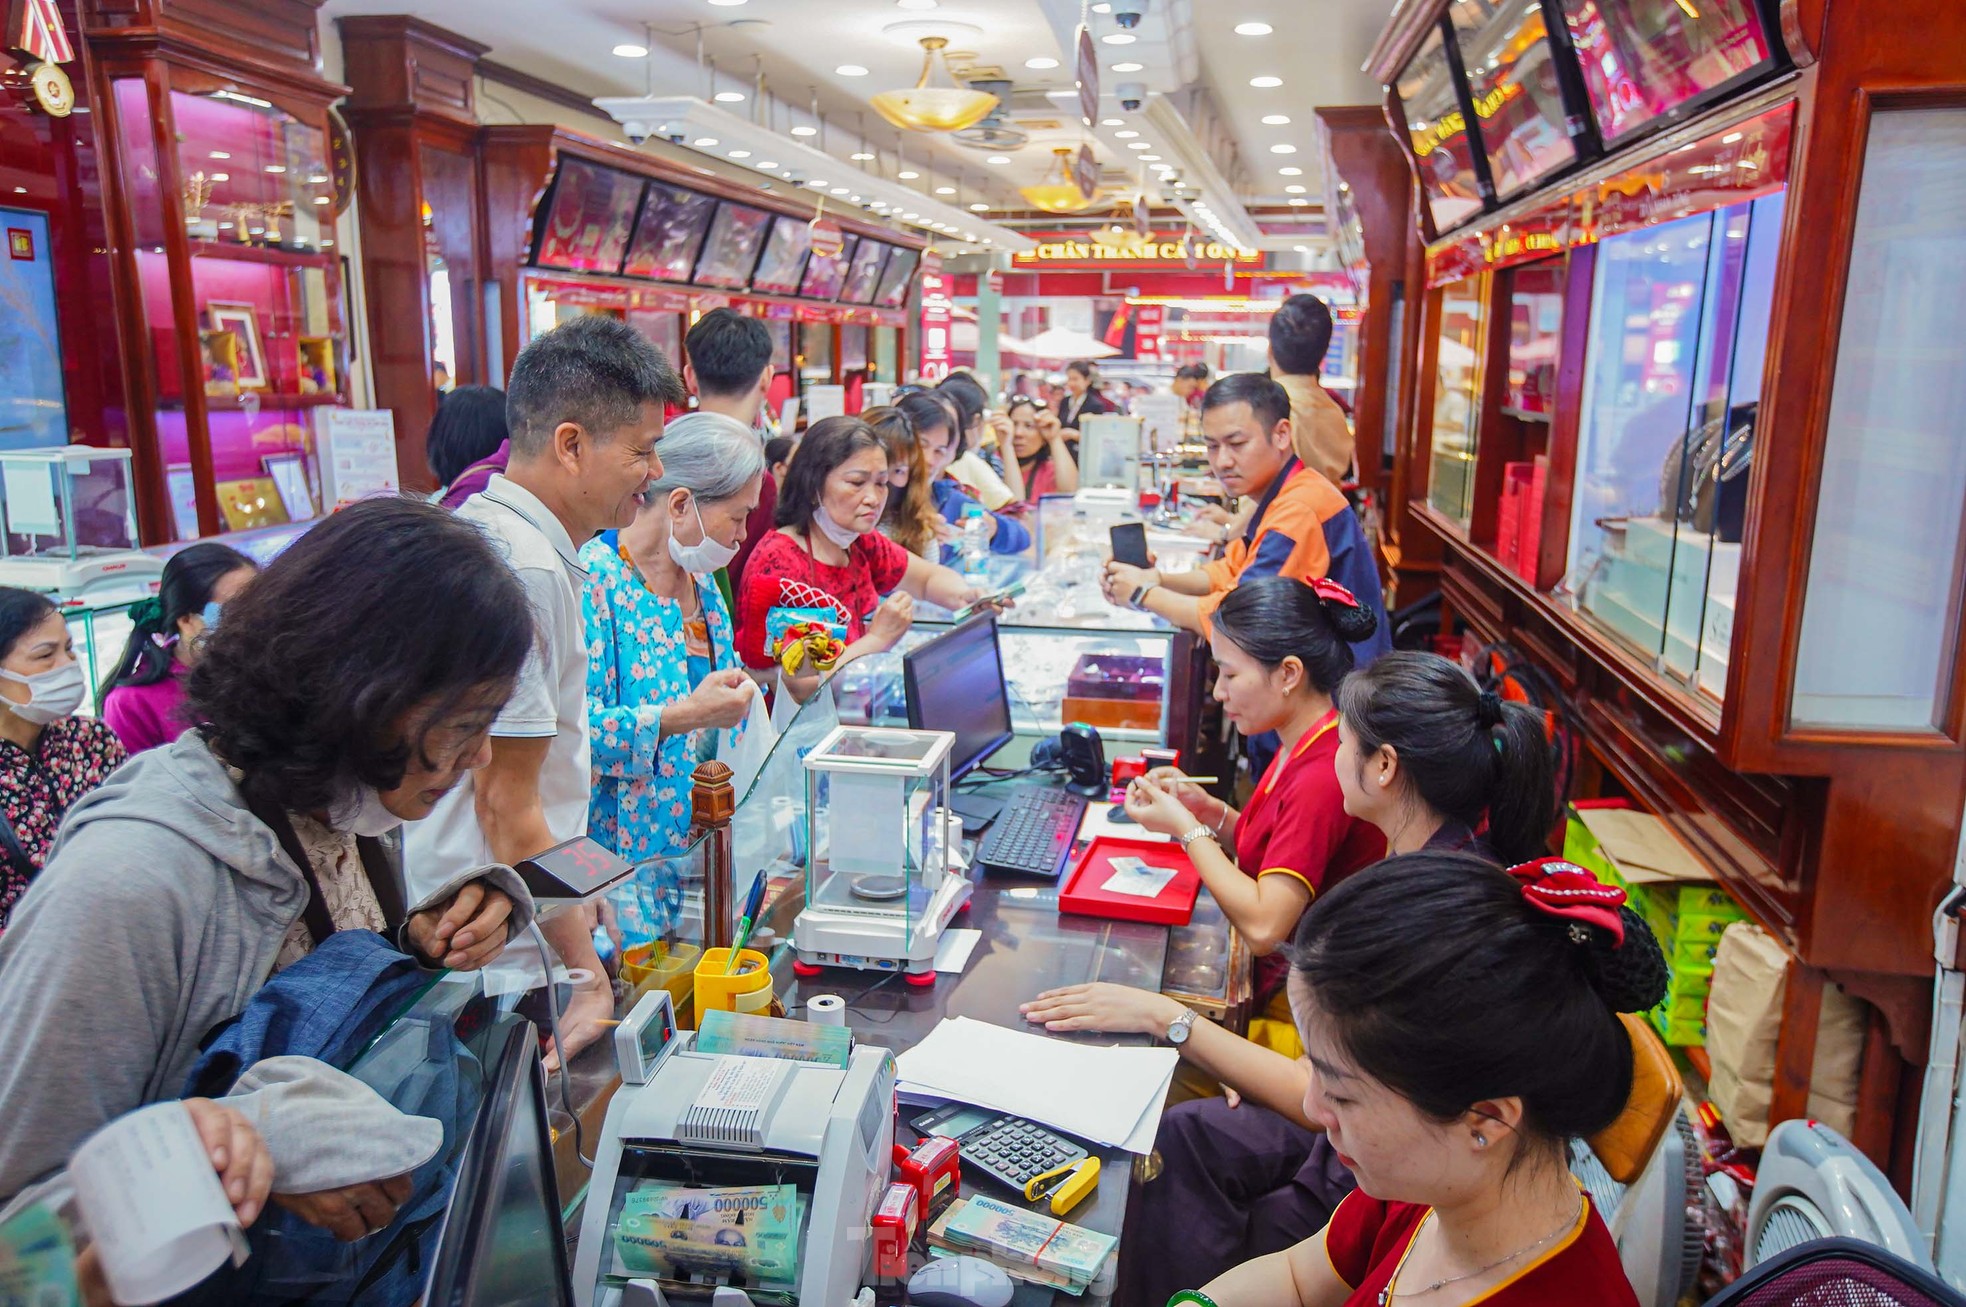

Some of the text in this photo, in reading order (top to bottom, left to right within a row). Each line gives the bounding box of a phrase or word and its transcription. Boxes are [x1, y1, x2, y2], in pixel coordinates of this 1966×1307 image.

[1038, 240, 1089, 259] CHÂN
[714, 1195, 768, 1213] 500000
[974, 1199, 1016, 1218] 500000
